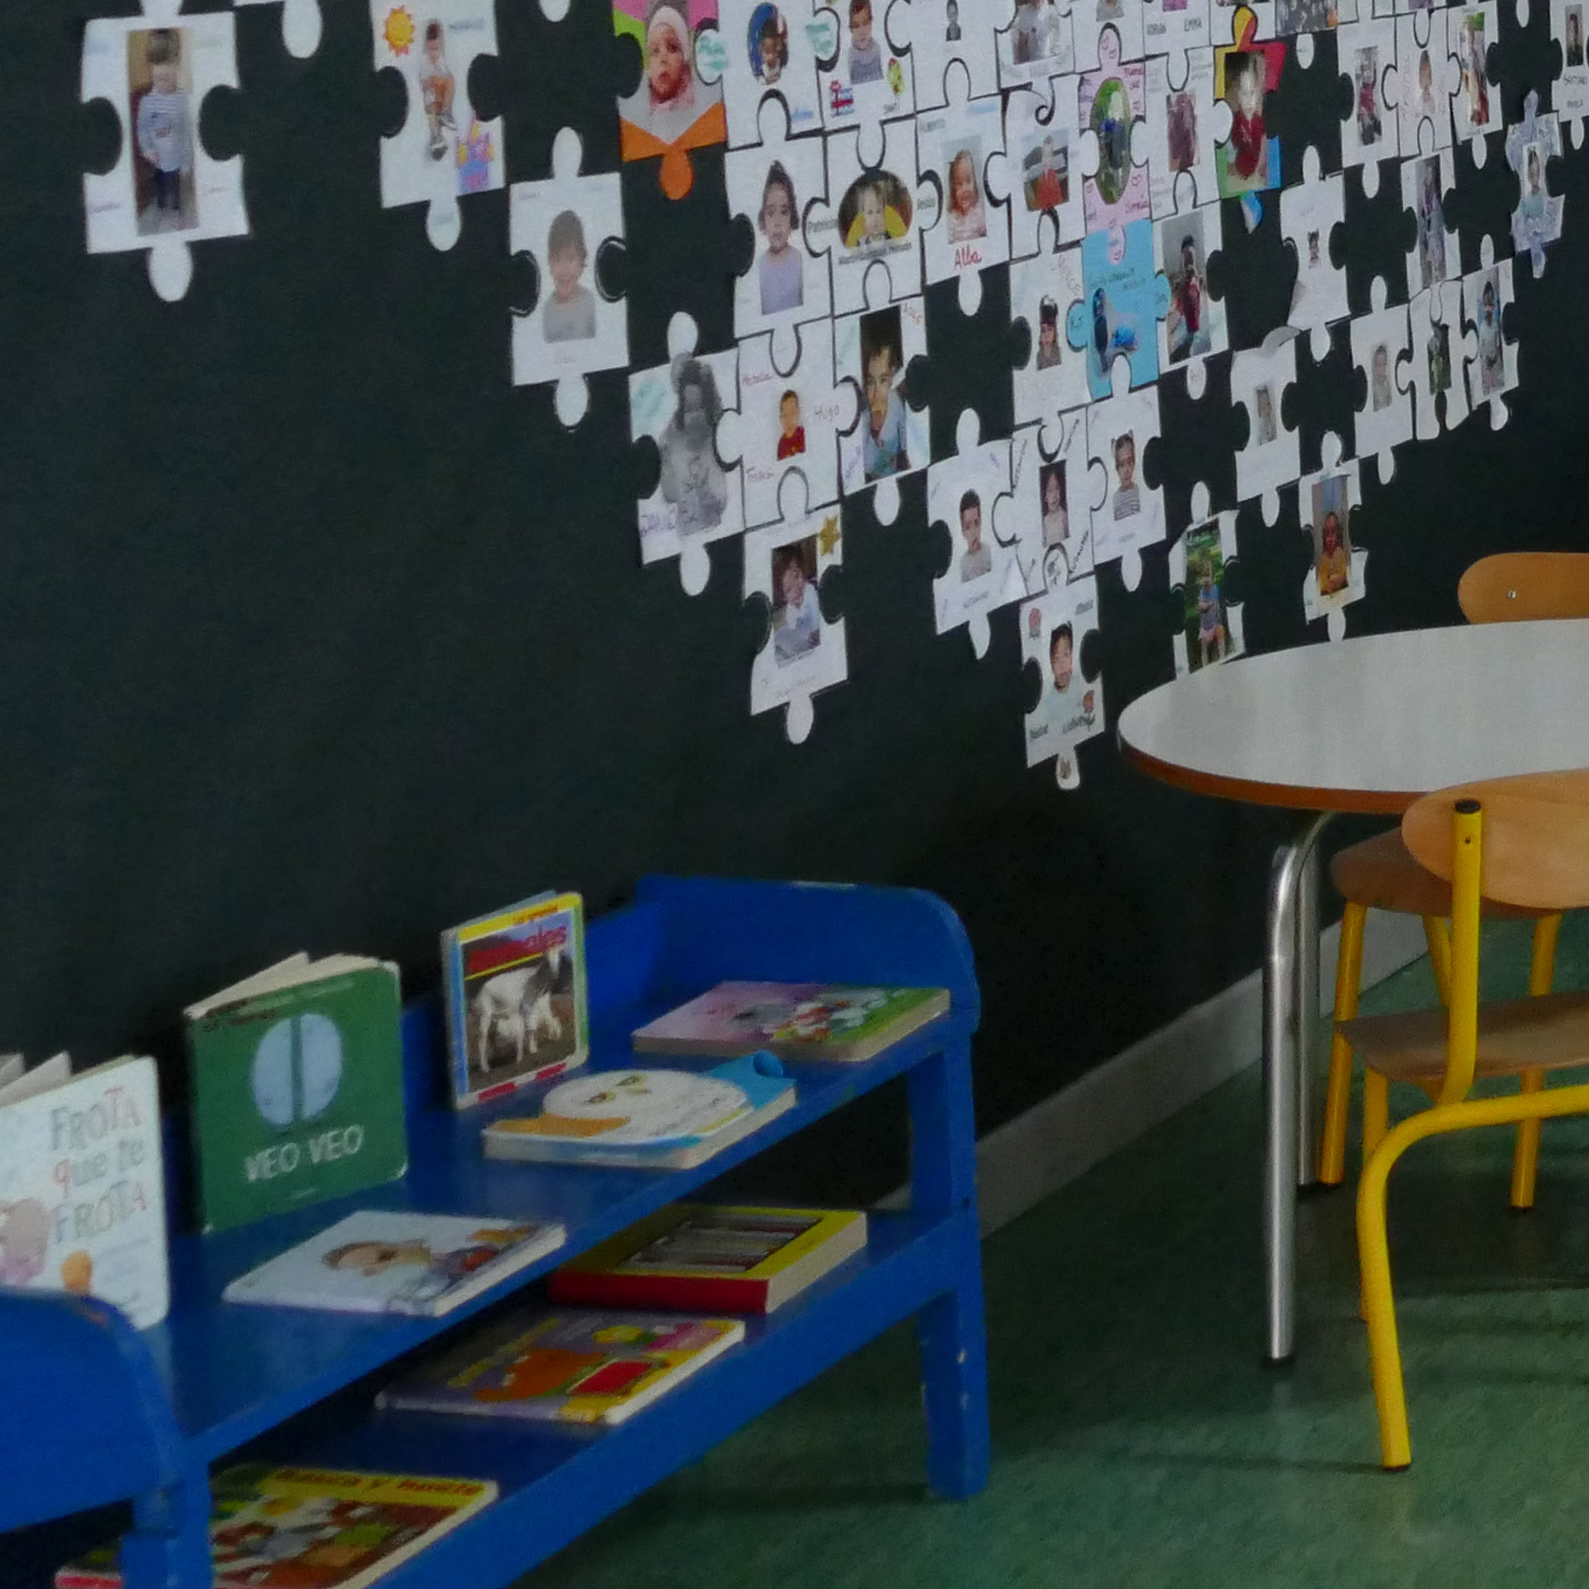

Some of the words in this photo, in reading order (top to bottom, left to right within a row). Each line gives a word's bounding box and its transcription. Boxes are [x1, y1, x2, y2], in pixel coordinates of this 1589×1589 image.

[954, 246, 982, 268] Alba
[49, 1086, 142, 1150] FROTA
[244, 1142, 301, 1183] VEO
[308, 1124, 364, 1164] VEO
